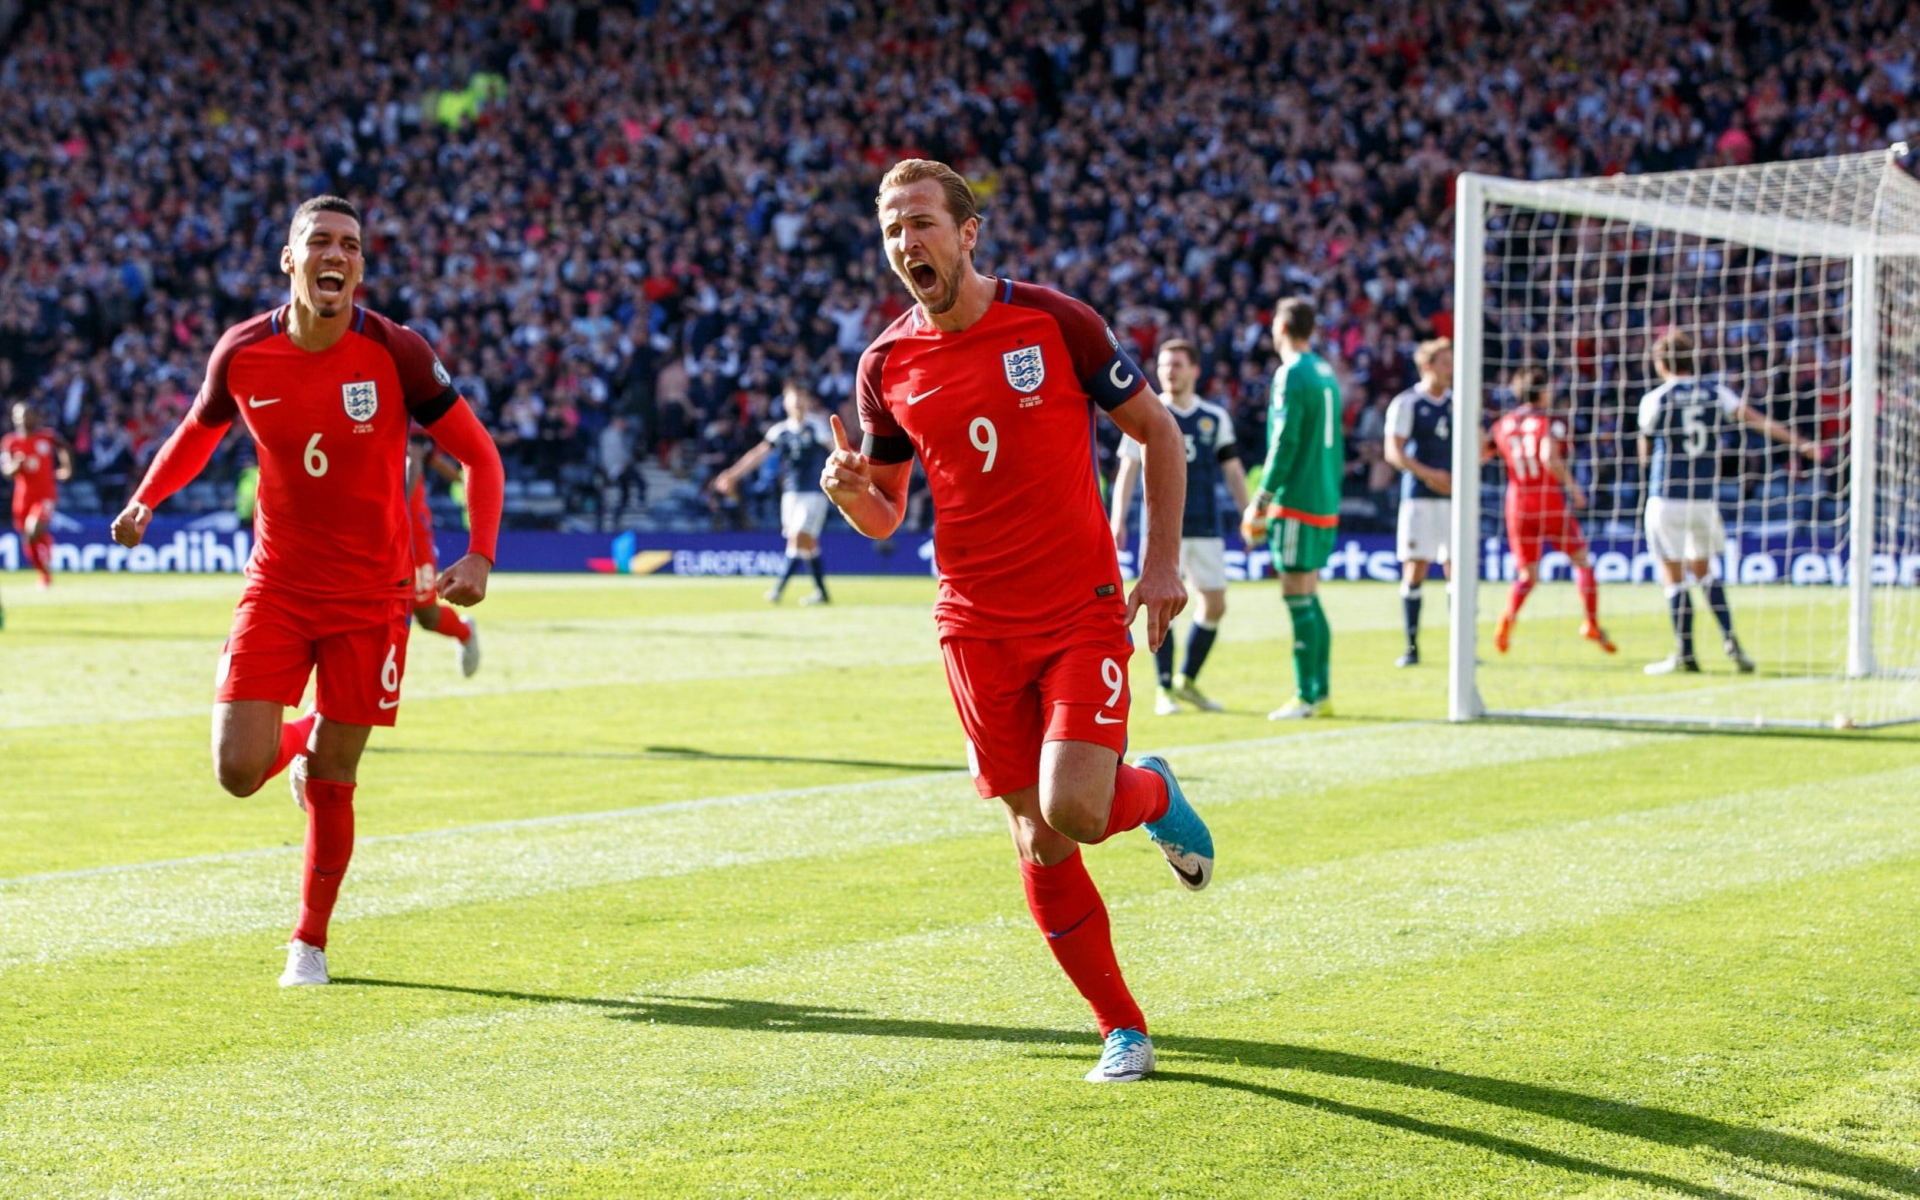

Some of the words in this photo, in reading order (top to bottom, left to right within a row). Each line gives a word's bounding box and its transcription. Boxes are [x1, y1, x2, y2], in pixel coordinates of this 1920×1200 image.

[1110, 360, 1134, 389] C
[1324, 387, 1334, 449] 1
[1682, 405, 1708, 457] 5
[304, 433, 328, 477] 6
[968, 416, 998, 473] 9
[1510, 434, 1539, 479] 11
[381, 643, 399, 693] 6
[1101, 657, 1123, 708] 9
